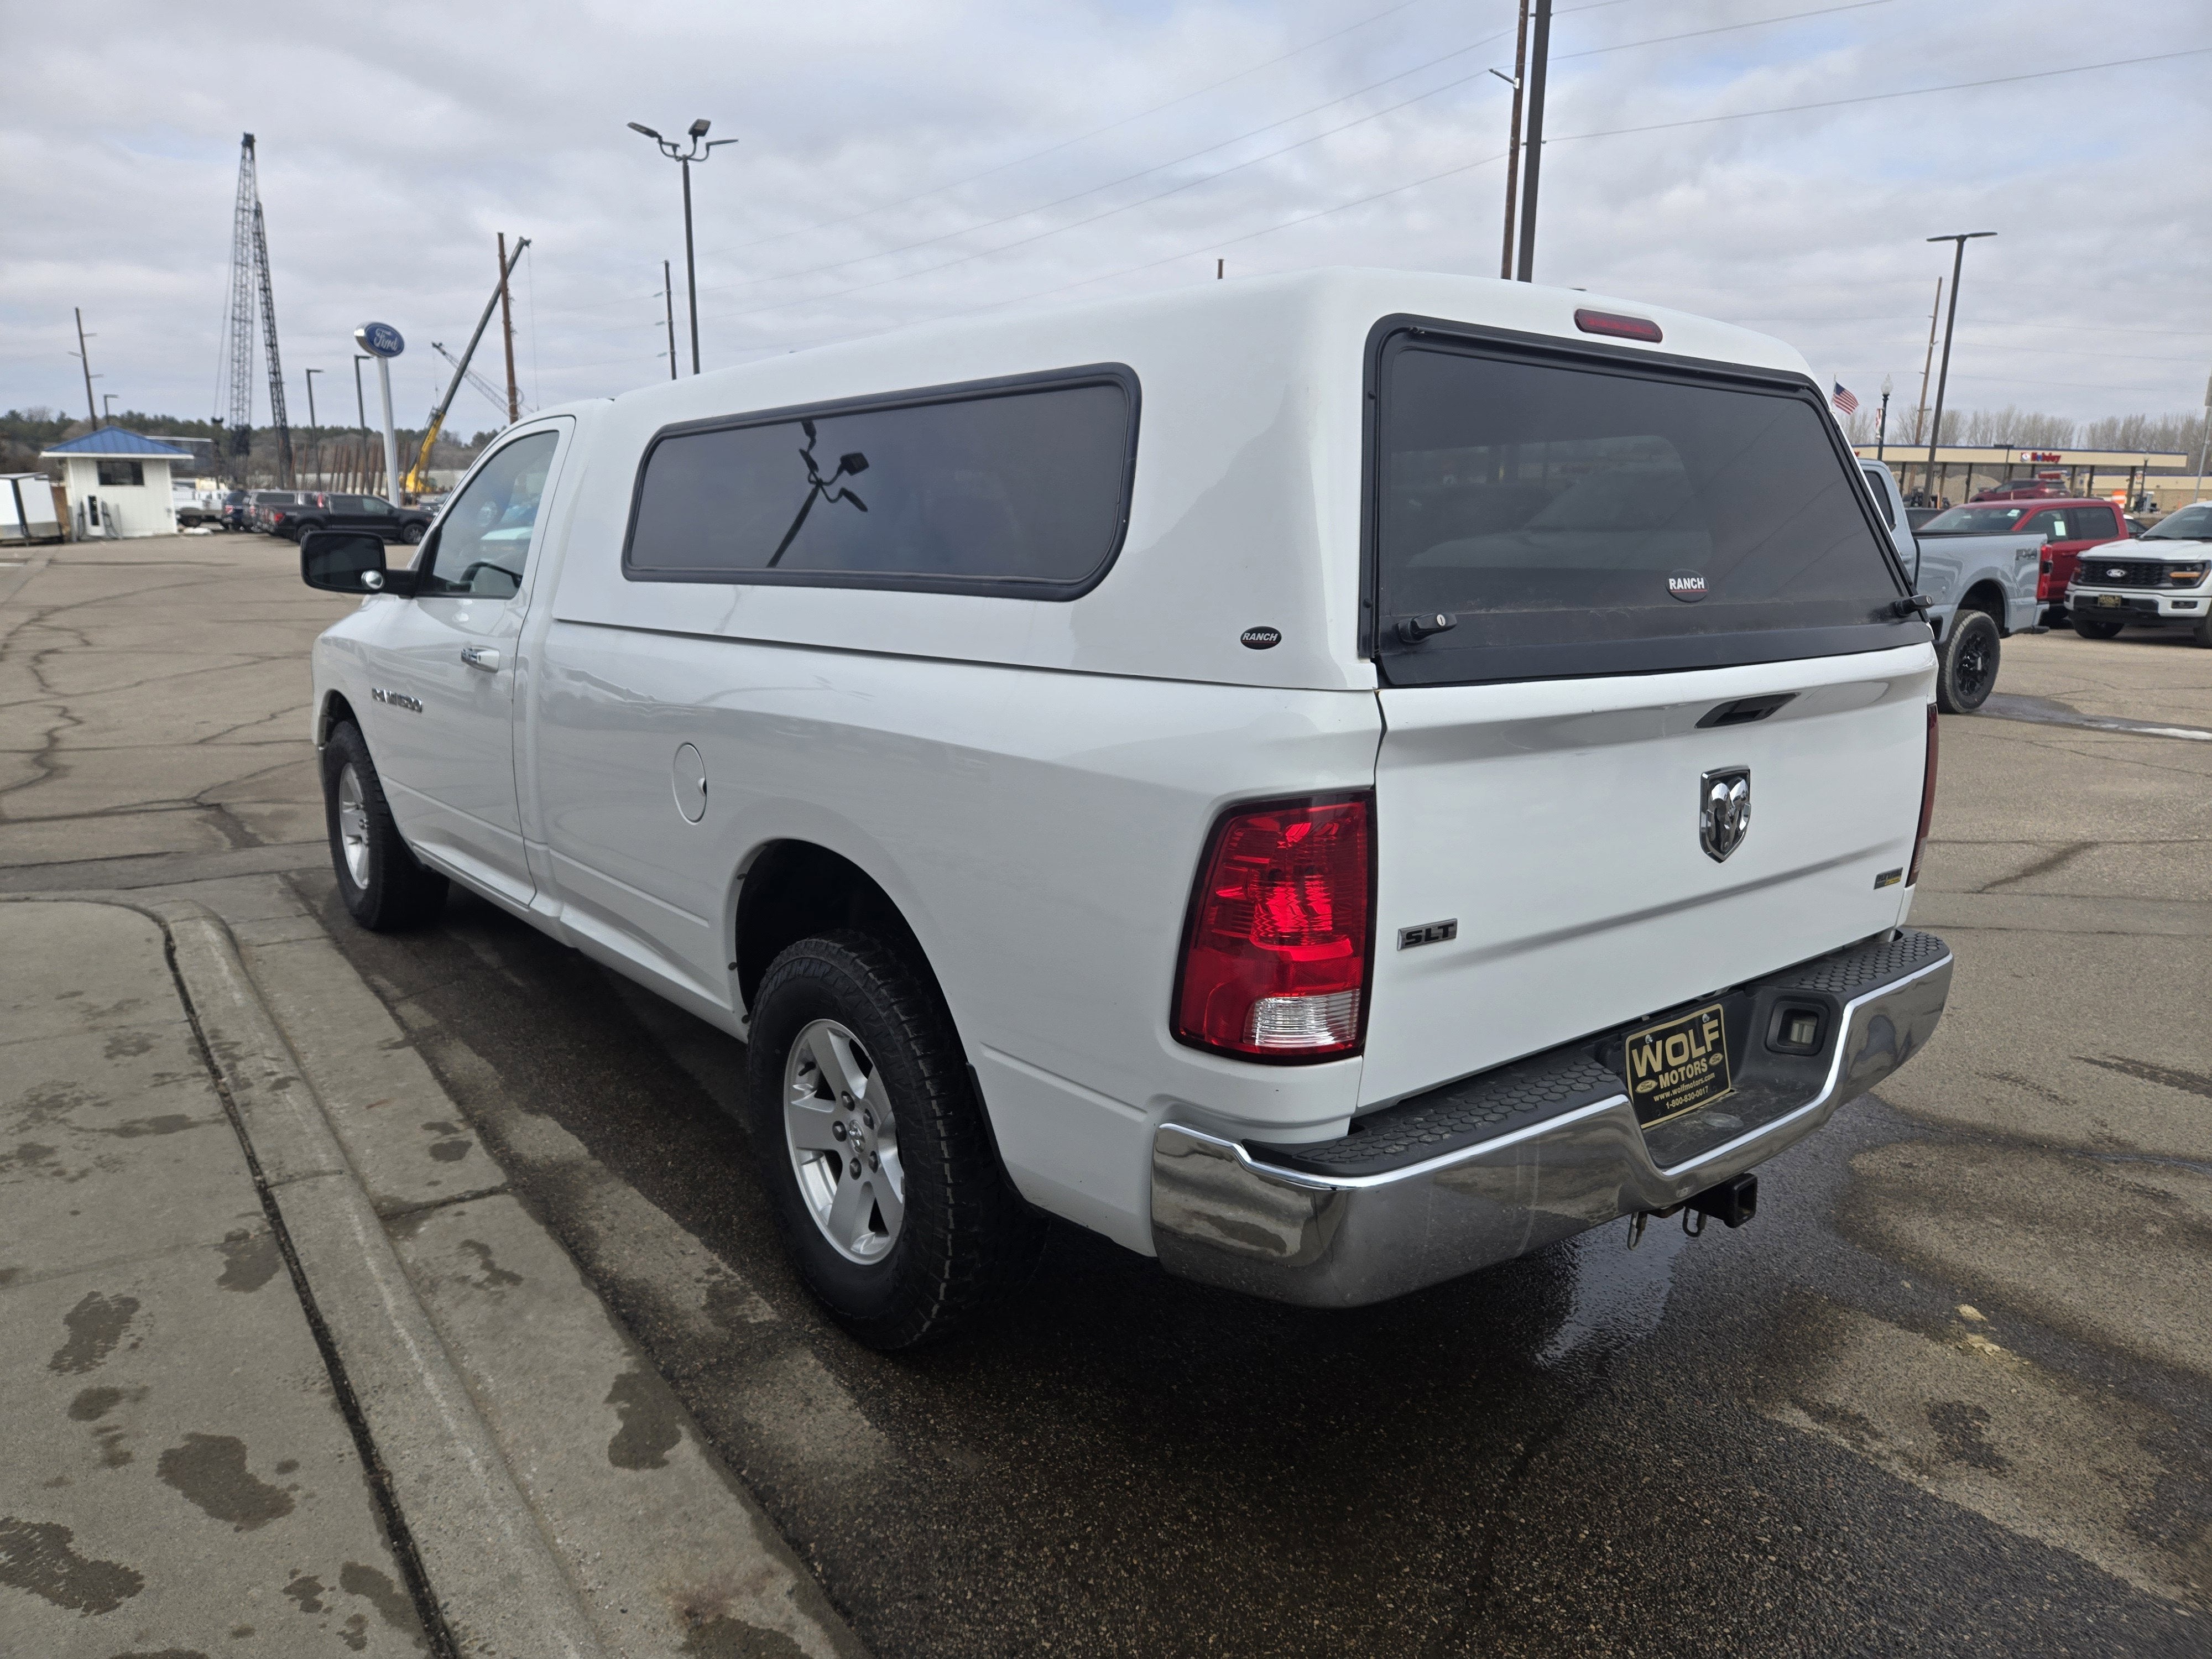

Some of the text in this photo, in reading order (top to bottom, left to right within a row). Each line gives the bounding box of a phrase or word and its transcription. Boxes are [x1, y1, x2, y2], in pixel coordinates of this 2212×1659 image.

[373, 328, 398, 351] Ford
[1668, 577, 1705, 589] RANCH
[1242, 633, 1279, 641] RANCH
[1405, 923, 1454, 946] SLT
[1631, 1019, 1720, 1078] WOLF
[1658, 1057, 1708, 1089] MOTORS
[1653, 1072, 1715, 1102] www.wolfmotors.com
[1666, 1085, 1709, 1109] 1-800-830-0017
